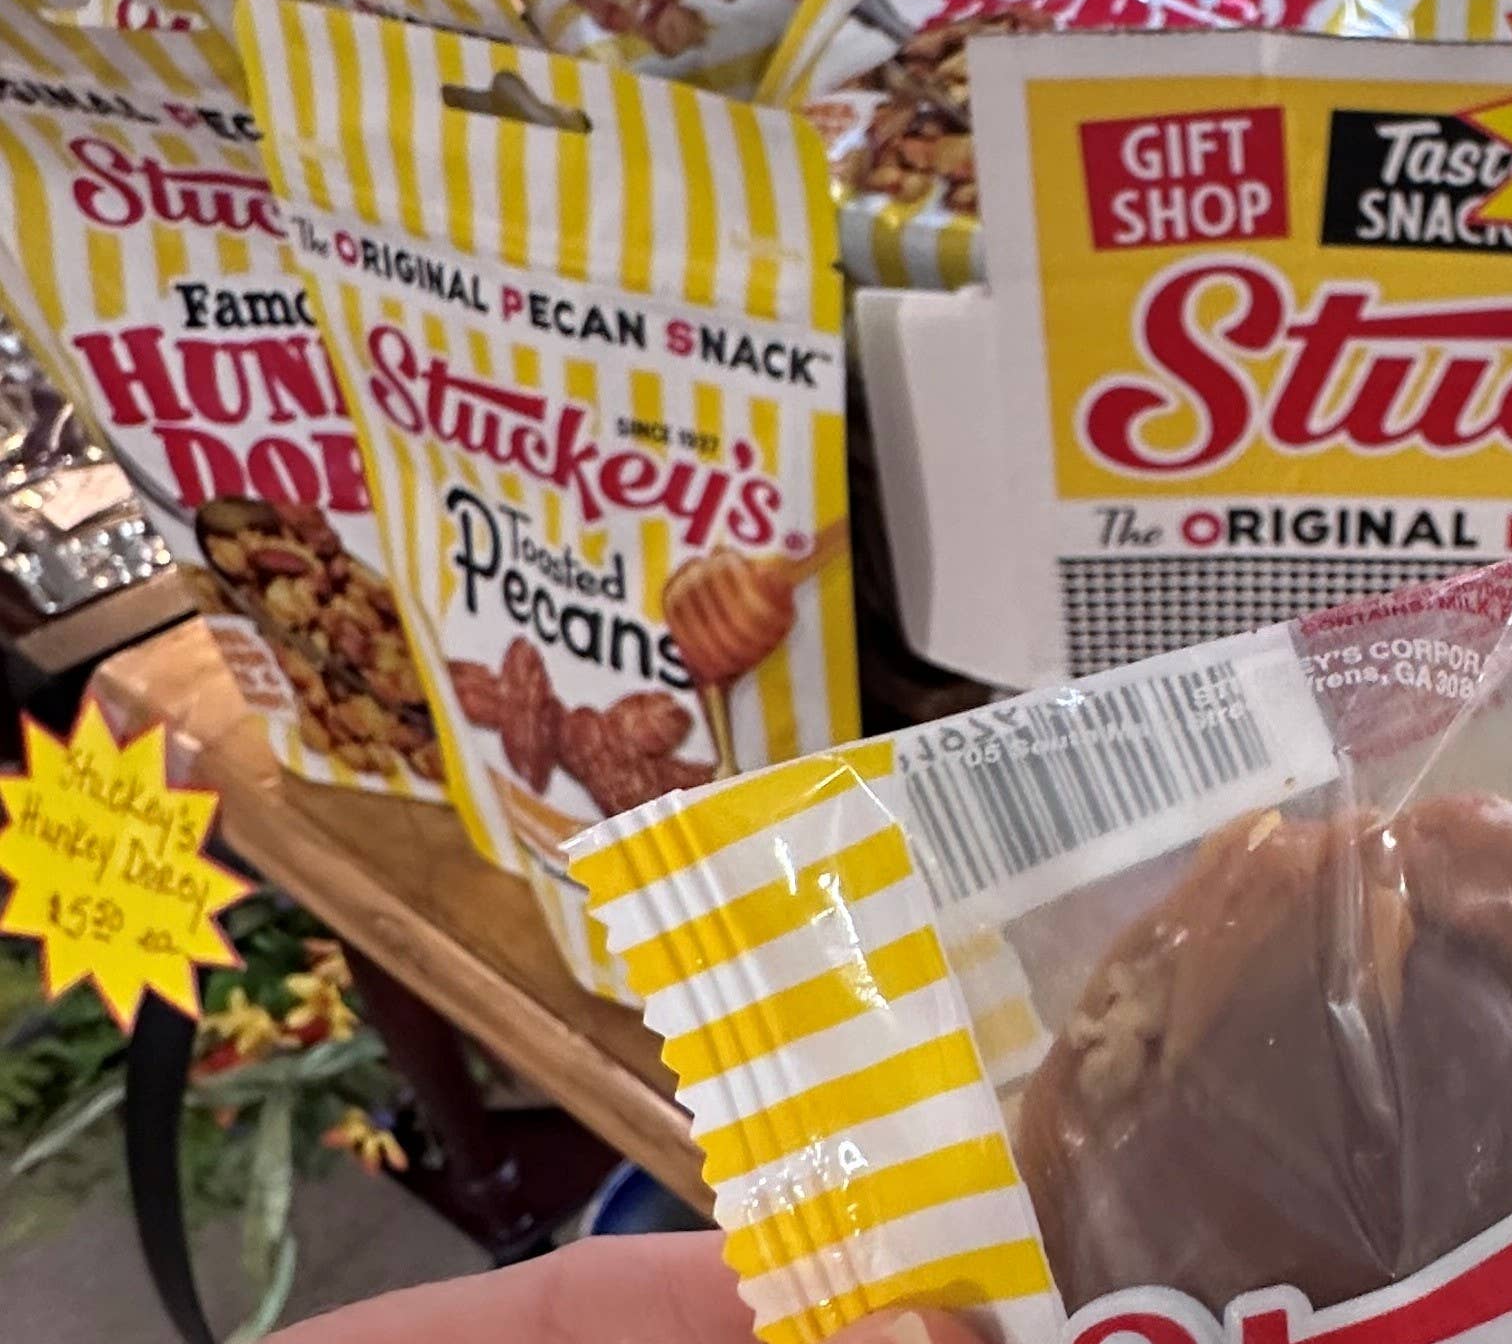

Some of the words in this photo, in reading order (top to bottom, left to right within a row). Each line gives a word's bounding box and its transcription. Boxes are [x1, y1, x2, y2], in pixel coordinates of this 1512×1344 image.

[70, 136, 288, 240] Stuc
[1120, 120, 1252, 180] GIFT
[1112, 183, 1271, 244] SHOP
[334, 230, 489, 314] ORIGINAL
[501, 285, 647, 350] PECAN
[664, 318, 818, 388] SNACK
[366, 324, 782, 552] Stuckey's
[500, 506, 626, 600] Toasted
[1099, 508, 1165, 549] The
[1182, 508, 1478, 550] ORIGINAL
[446, 486, 696, 690] Pecans
